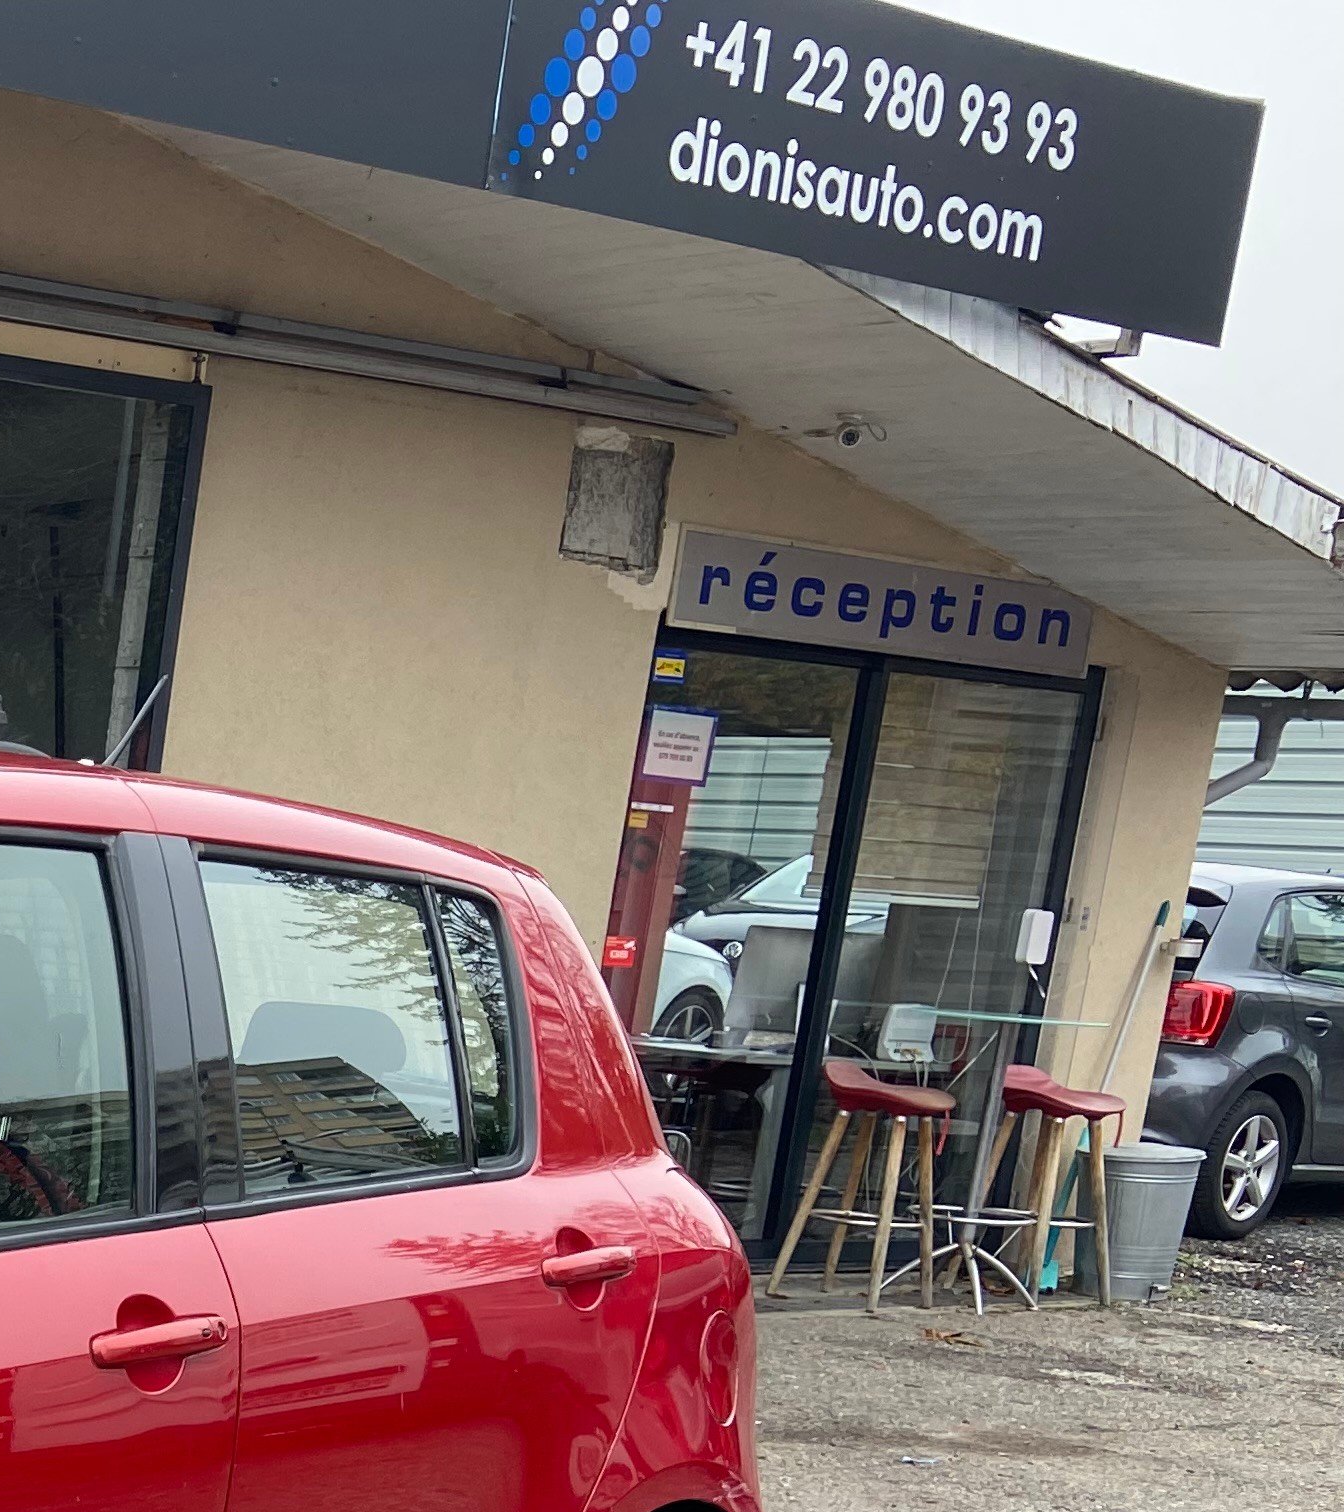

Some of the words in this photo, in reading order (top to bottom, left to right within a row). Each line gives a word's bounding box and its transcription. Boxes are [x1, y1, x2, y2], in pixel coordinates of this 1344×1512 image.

[686, 20, 772, 94] +41
[786, 38, 849, 114] 22
[863, 57, 945, 138] 980
[958, 83, 1011, 155] 93
[1025, 101, 1078, 171] 93
[669, 117, 1044, 262] dionisauto.com
[699, 551, 1072, 648] réception
